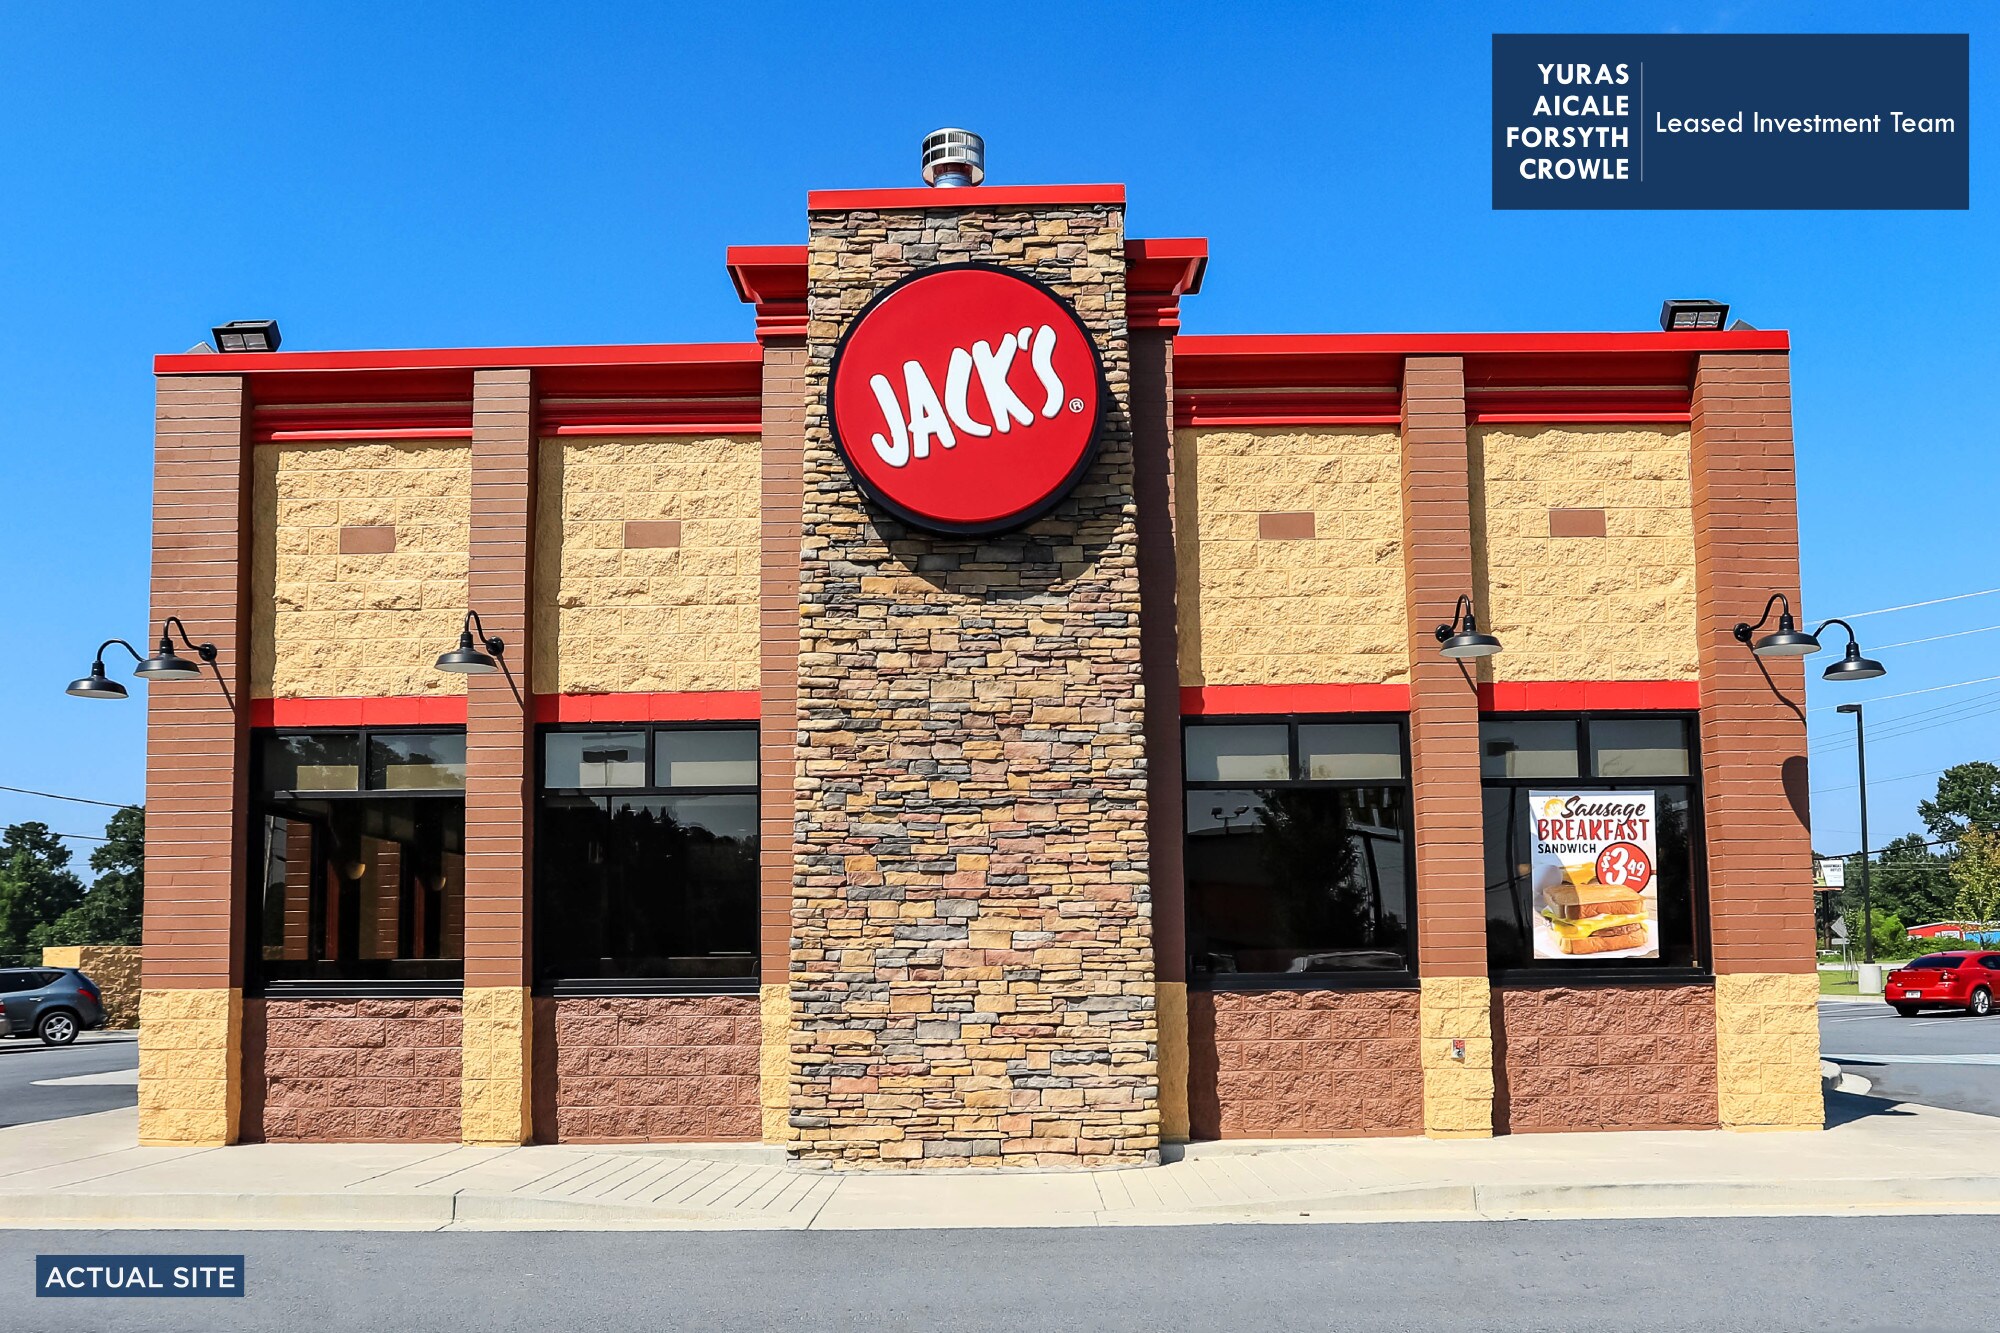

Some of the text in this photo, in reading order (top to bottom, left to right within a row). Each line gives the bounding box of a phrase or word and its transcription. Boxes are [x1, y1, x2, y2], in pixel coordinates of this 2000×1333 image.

[869, 324, 1065, 468] JACK'S
[1560, 795, 1646, 826] Sausage
[1537, 818, 1650, 841] BREAKFAST
[1537, 843, 1597, 854] SANDWICH
